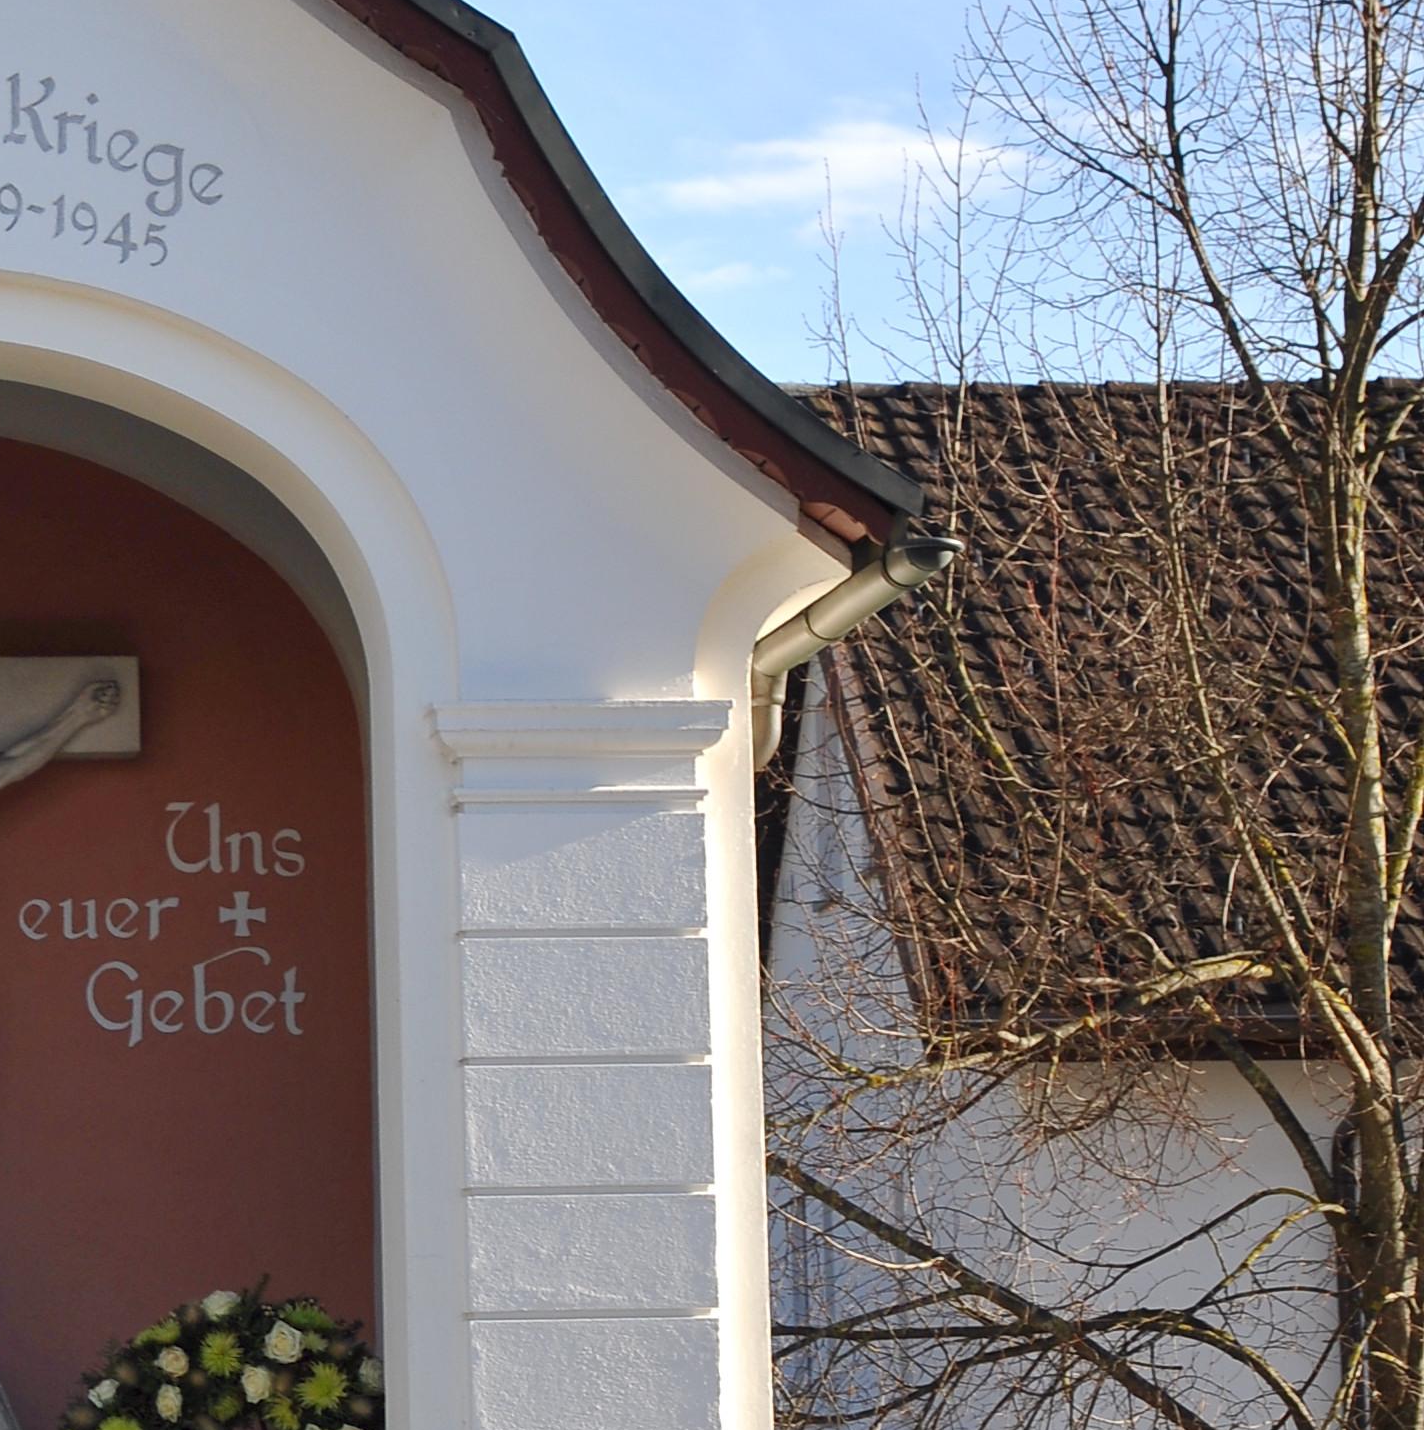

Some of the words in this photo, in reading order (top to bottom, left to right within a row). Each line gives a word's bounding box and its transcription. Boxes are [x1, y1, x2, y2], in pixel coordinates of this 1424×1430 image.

[2, 72, 225, 218] Kriege
[164, 801, 306, 877] Uns
[18, 897, 180, 942] euer
[86, 946, 307, 1049] Gebet
